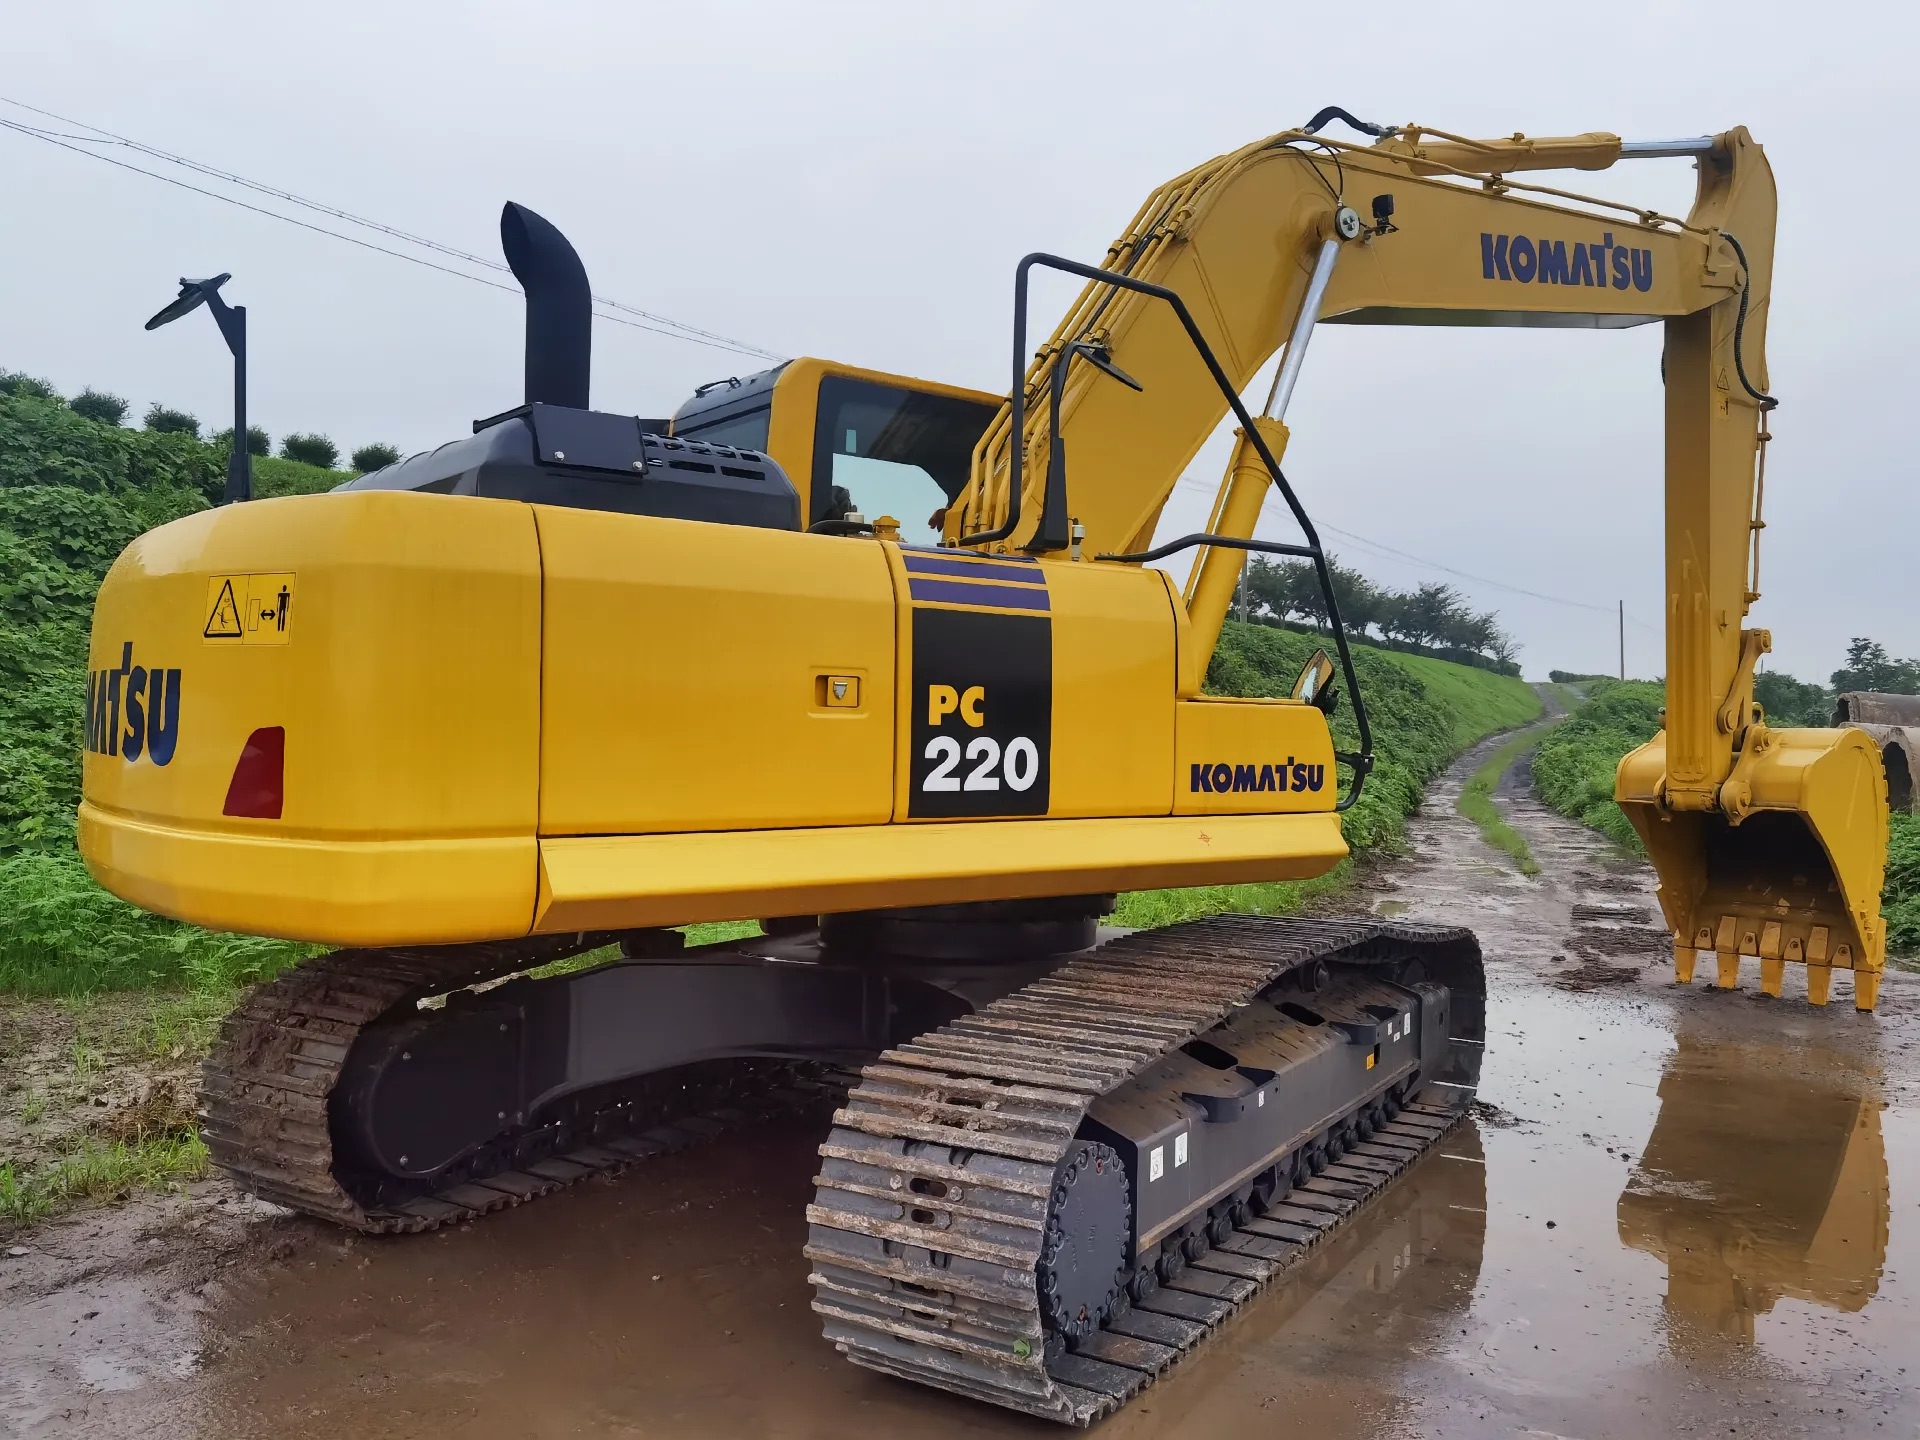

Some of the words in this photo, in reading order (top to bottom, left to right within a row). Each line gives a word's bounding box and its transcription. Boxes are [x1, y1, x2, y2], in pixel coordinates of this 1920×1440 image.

[1480, 232, 1653, 292] KOMATSU
[928, 684, 985, 728] PC
[922, 735, 1039, 792] 220
[1190, 756, 1324, 793] KOMATSU
